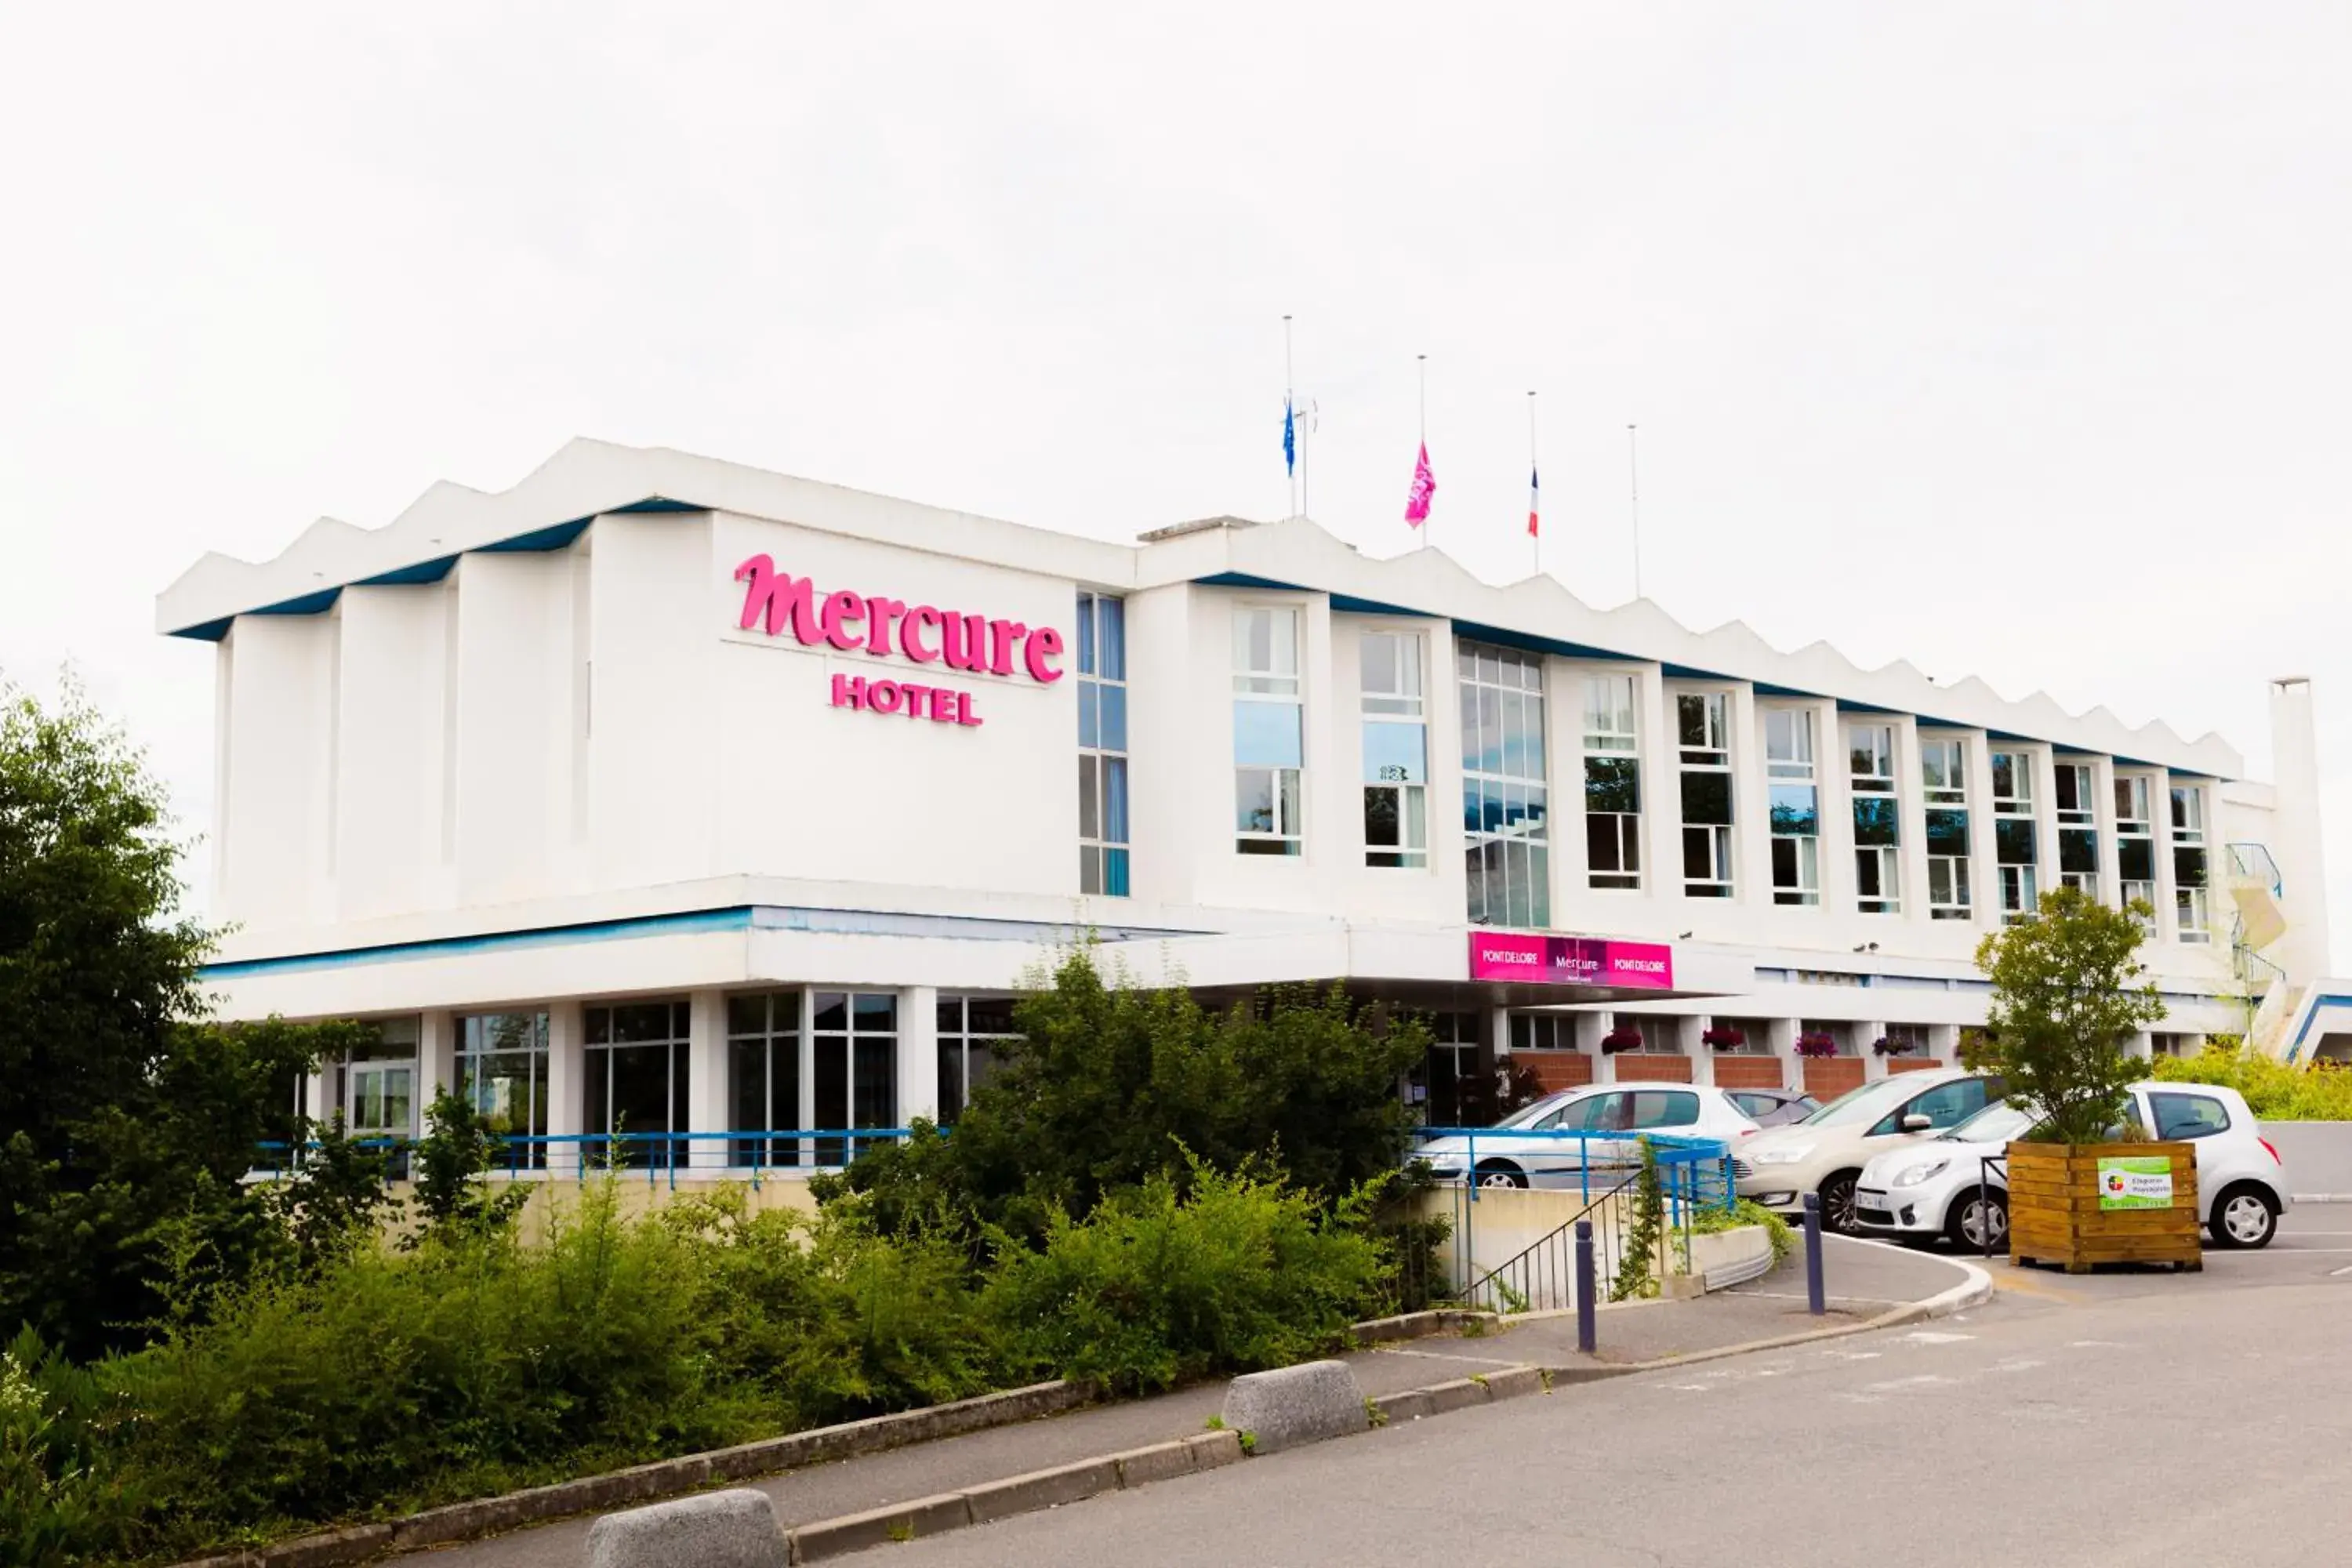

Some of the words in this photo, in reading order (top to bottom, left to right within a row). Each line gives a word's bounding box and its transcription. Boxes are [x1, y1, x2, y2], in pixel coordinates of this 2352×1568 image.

[734, 554, 1064, 683] Mercure
[832, 673, 983, 726] HOTEL
[1555, 956, 1599, 971] Mercure
